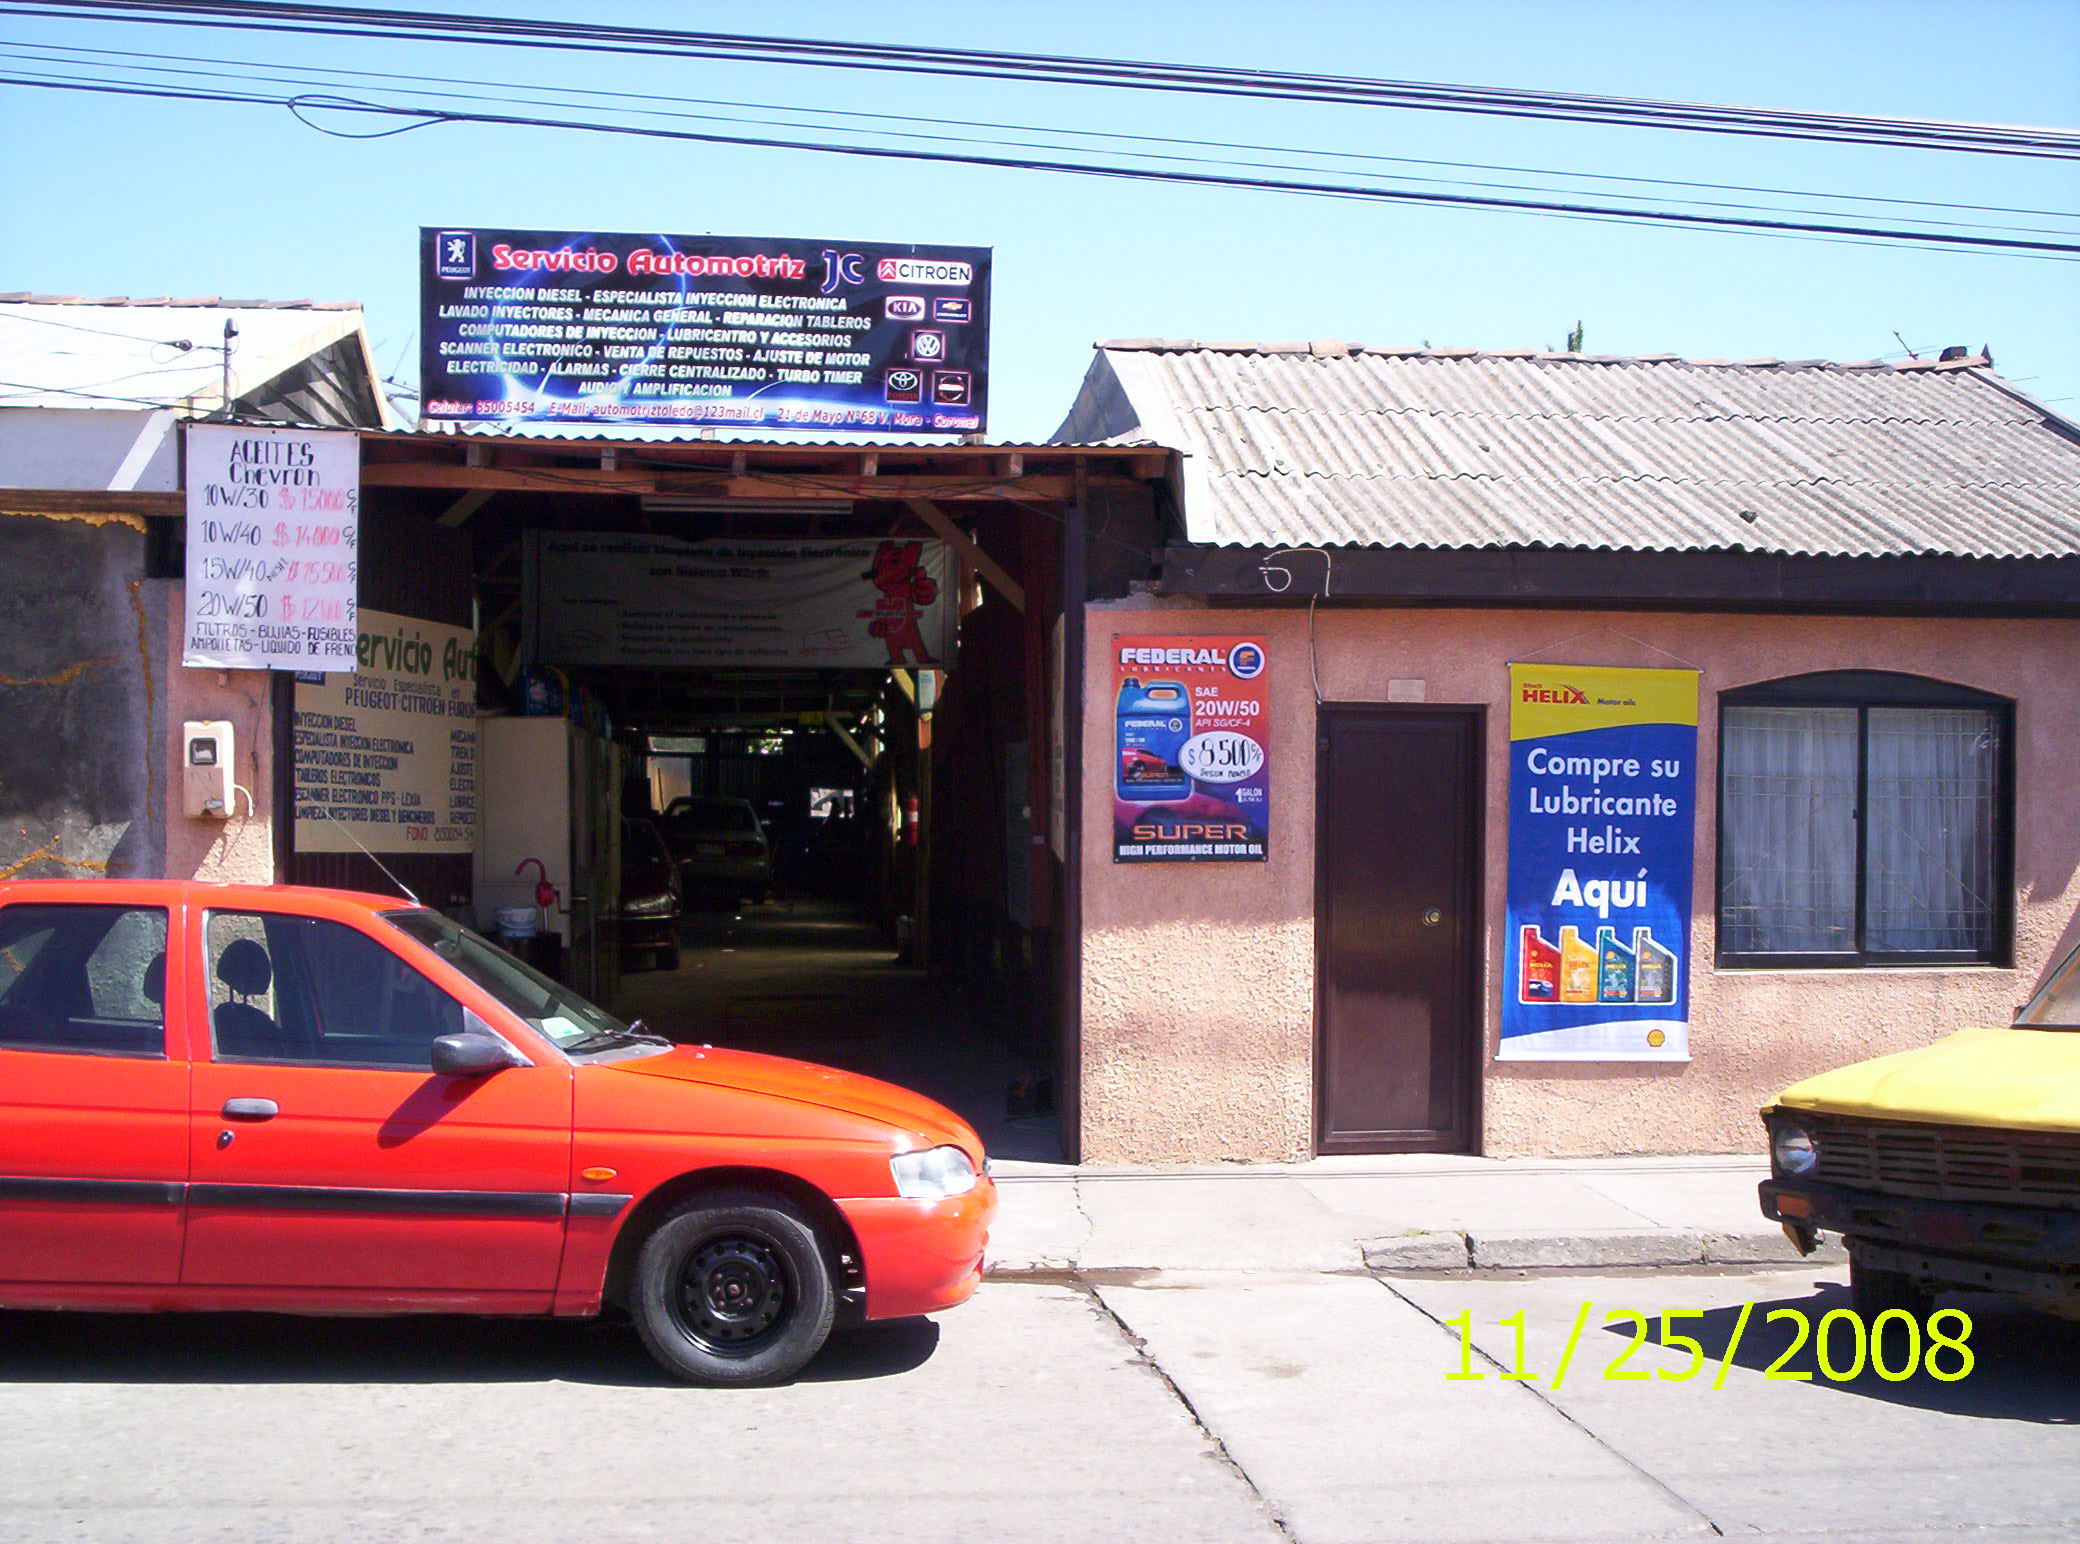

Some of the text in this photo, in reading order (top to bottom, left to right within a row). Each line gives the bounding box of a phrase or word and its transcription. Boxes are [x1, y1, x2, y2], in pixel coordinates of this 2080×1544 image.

[492, 244, 864, 294] Servicio Automotriz JC
[463, 286, 848, 311] INYECCION DIESEL ESPECIALISTA INYECCION ELECTRONICA
[893, 301, 917, 313] KIA
[439, 305, 872, 330] LAVADO INYECTORES MECANICA GENERAL REPARACION TABLEROS
[459, 323, 852, 348] COMPUTADORES DE INYECCION LUBRICENTRO Y ACCESORIOS
[439, 342, 871, 366] SCANNER ELECTRONICO VENTA DE REPUESTOS AJUSTE DE MOTOR
[447, 361, 863, 384] ELECTRICIDAD ALARMAS CIERRE CENTRALIZADO TURBO TIMER
[578, 381, 732, 397] AUDIO Y AMPLIFICACION
[794, 409, 808, 421] de
[812, 410, 842, 426] Mayo
[230, 440, 314, 466] ACEITES
[229, 461, 320, 486] Chevron
[203, 483, 269, 508] 10W/30
[201, 519, 261, 546] 10W/40
[202, 558, 266, 582] 15W/40
[197, 590, 268, 618] 20W/50
[196, 621, 356, 642] FILTROS BUJIAS FUSIBLES
[308, 642, 320, 655] DE
[357, 629, 432, 675] ervicio
[1121, 648, 1226, 664] FEDERAL
[345, 687, 398, 710] PEUGEOT
[401, 694, 445, 716] CITROEN
[1195, 687, 1218, 697] SAE
[1522, 688, 1589, 704] HELIX
[1195, 701, 1260, 716] 20W/50
[1528, 748, 1680, 784] Compre su
[1530, 785, 1677, 816] Lubricante
[1133, 824, 1248, 840] SUPER
[1567, 825, 1641, 854] Helix
[1119, 844, 1264, 855] HIGH PERFORMANCE MOTOR OIL
[1551, 867, 1648, 919] Aquí
